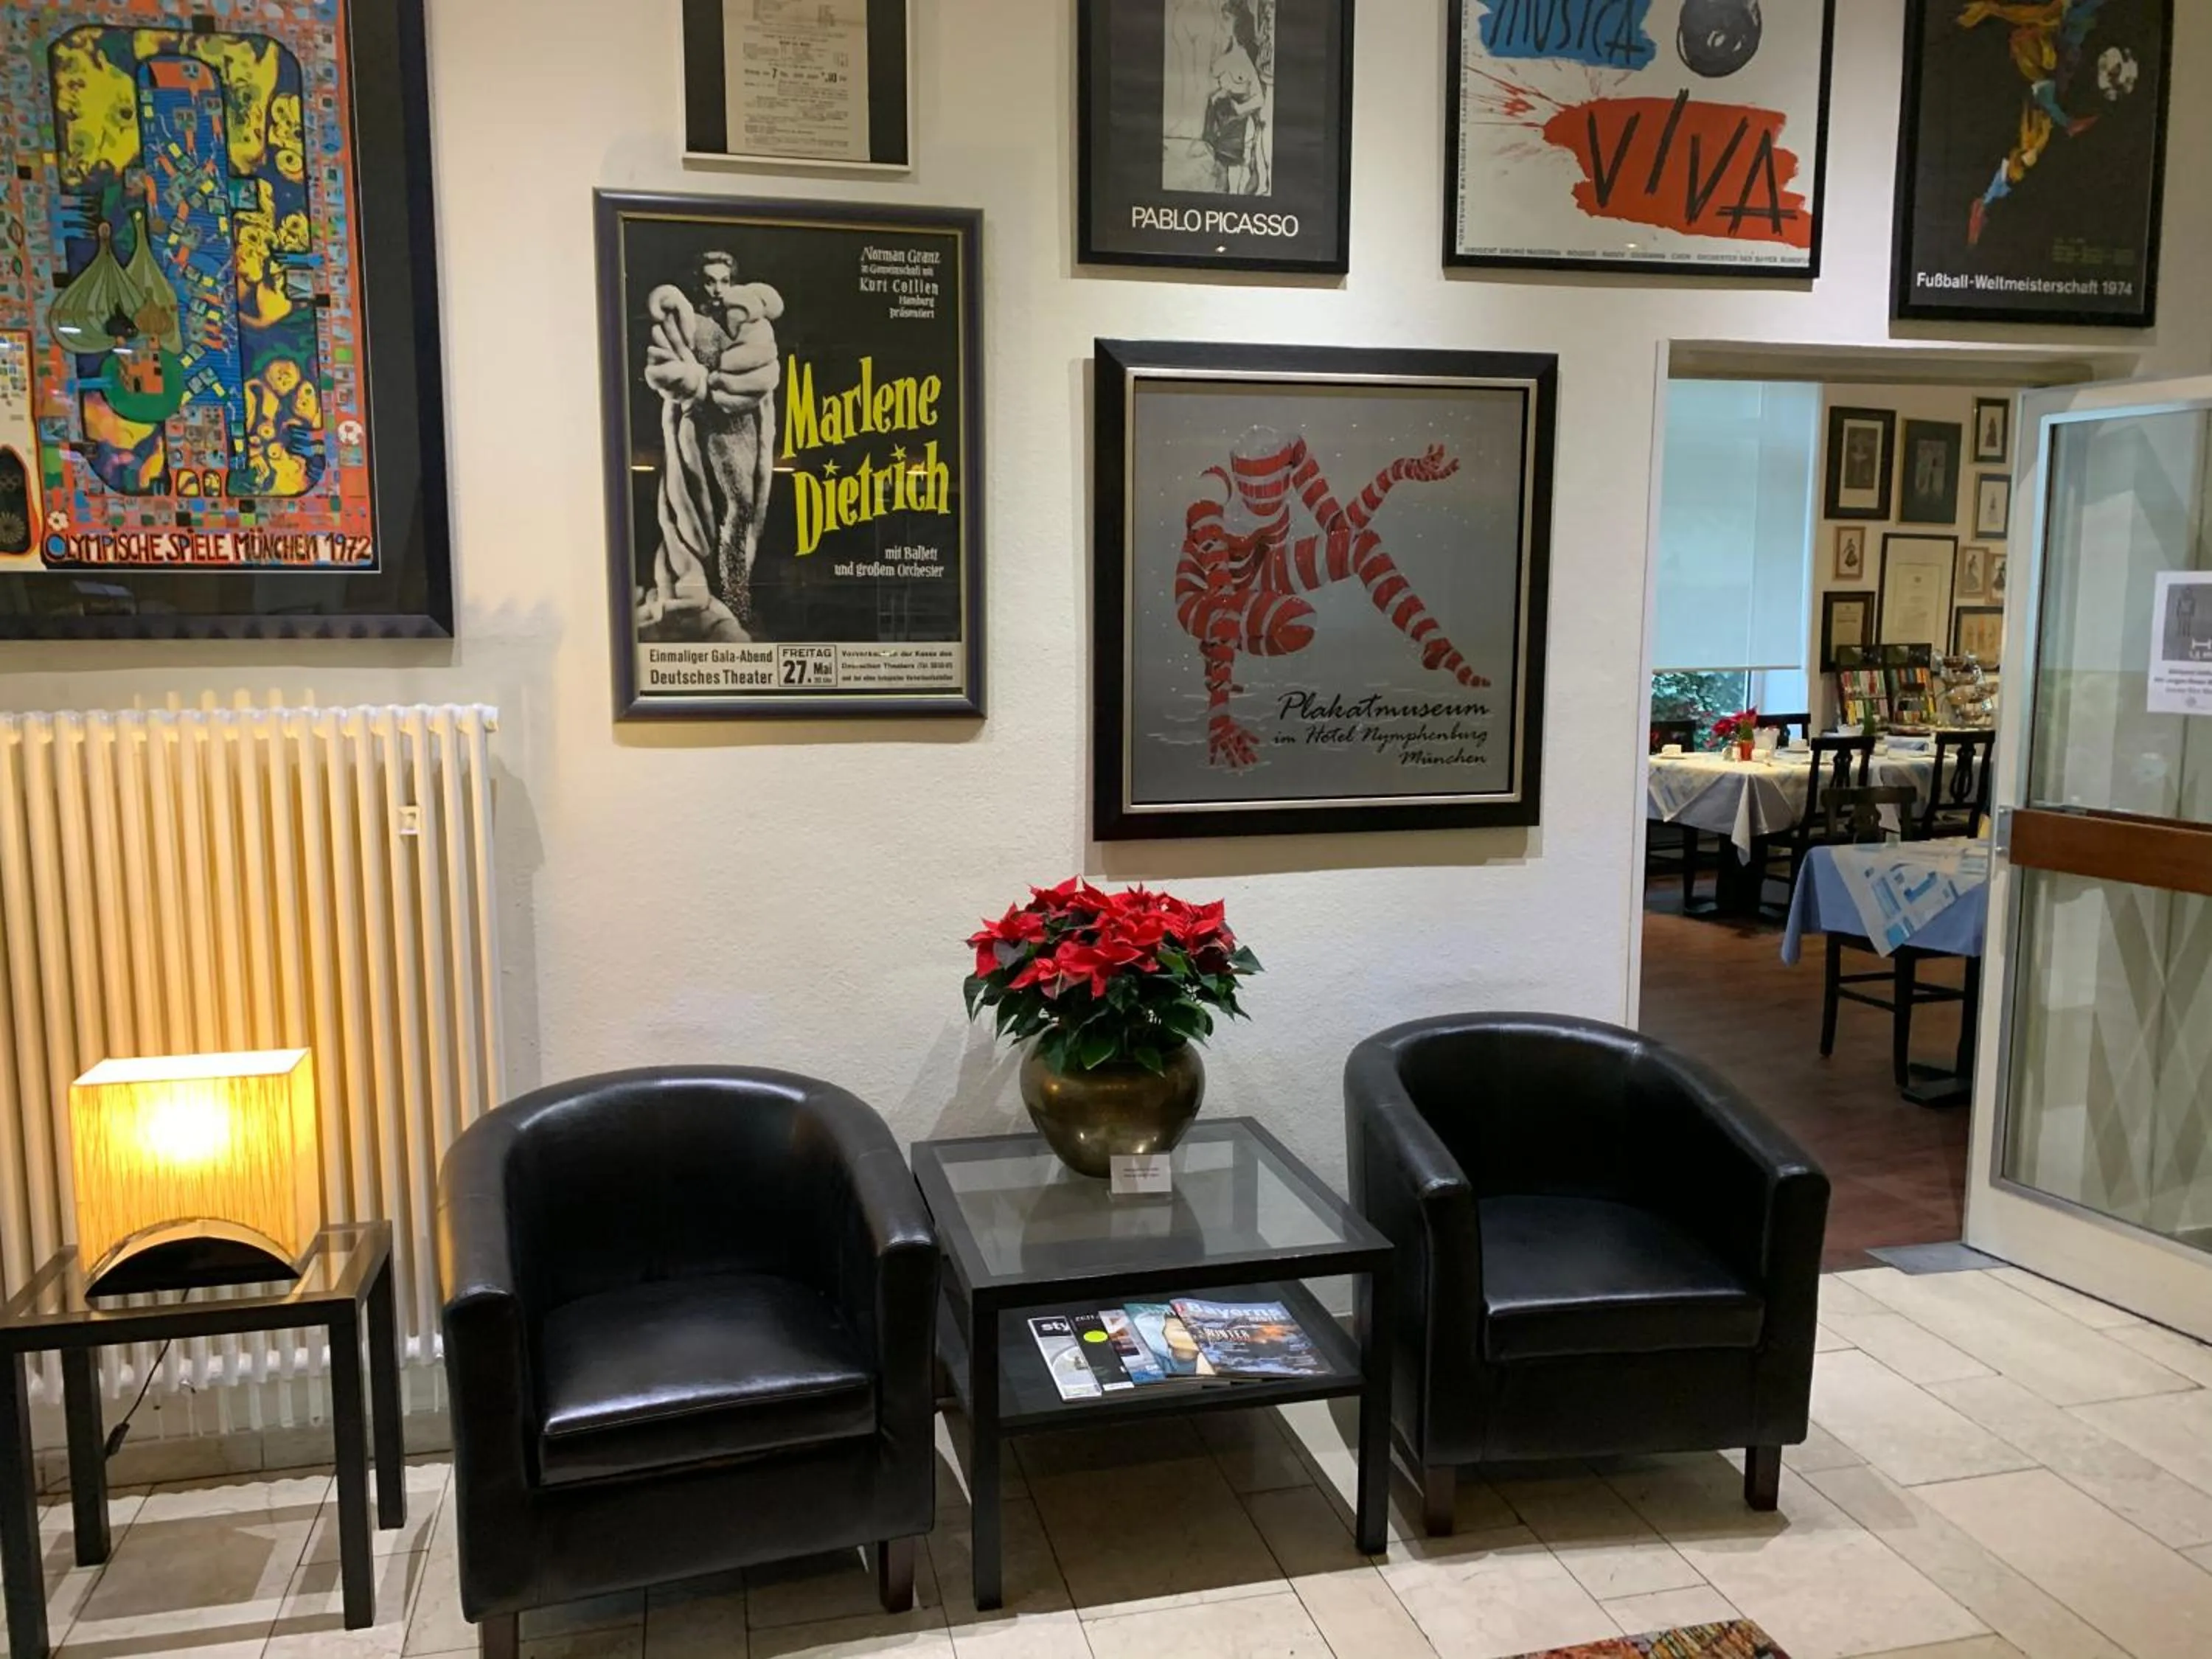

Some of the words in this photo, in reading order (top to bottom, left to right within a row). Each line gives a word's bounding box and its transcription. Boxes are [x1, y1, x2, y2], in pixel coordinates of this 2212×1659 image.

[1587, 88, 1798, 237] VIVA
[1132, 206, 1201, 232] PABLO
[1206, 210, 1299, 237] PICASSO
[860, 246, 905, 263] Norman
[908, 249, 941, 264] Granz
[860, 277, 888, 293] Kurt
[1916, 271, 2098, 295] Fußball-Weltmeisterschaft
[2102, 281, 2132, 296] 1974
[899, 295, 934, 307] Hamburg
[889, 307, 934, 319] präsentiert
[780, 353, 942, 459] Marlene
[791, 439, 951, 557] Dietrich
[232, 526, 320, 565] MÜNCHEN
[324, 530, 374, 563] 1972
[885, 547, 902, 560] mit
[904, 546, 938, 561] Ballett
[835, 561, 854, 576] und
[856, 562, 895, 577] großem
[897, 563, 945, 578] Orchester
[650, 649, 709, 664] Einmaliger
[712, 650, 773, 664] Gala-Abend
[782, 648, 832, 658] FREITAG
[650, 669, 720, 685] Deutsches
[723, 669, 773, 686] Theater
[782, 660, 812, 685] 27.
[813, 661, 833, 676] Mai
[1277, 691, 1490, 720] Plakatmuseum
[1274, 731, 1296, 745] im
[1305, 724, 1354, 745] Hotel
[1361, 722, 1488, 754] Nymphenburg
[1398, 748, 1487, 765] München
